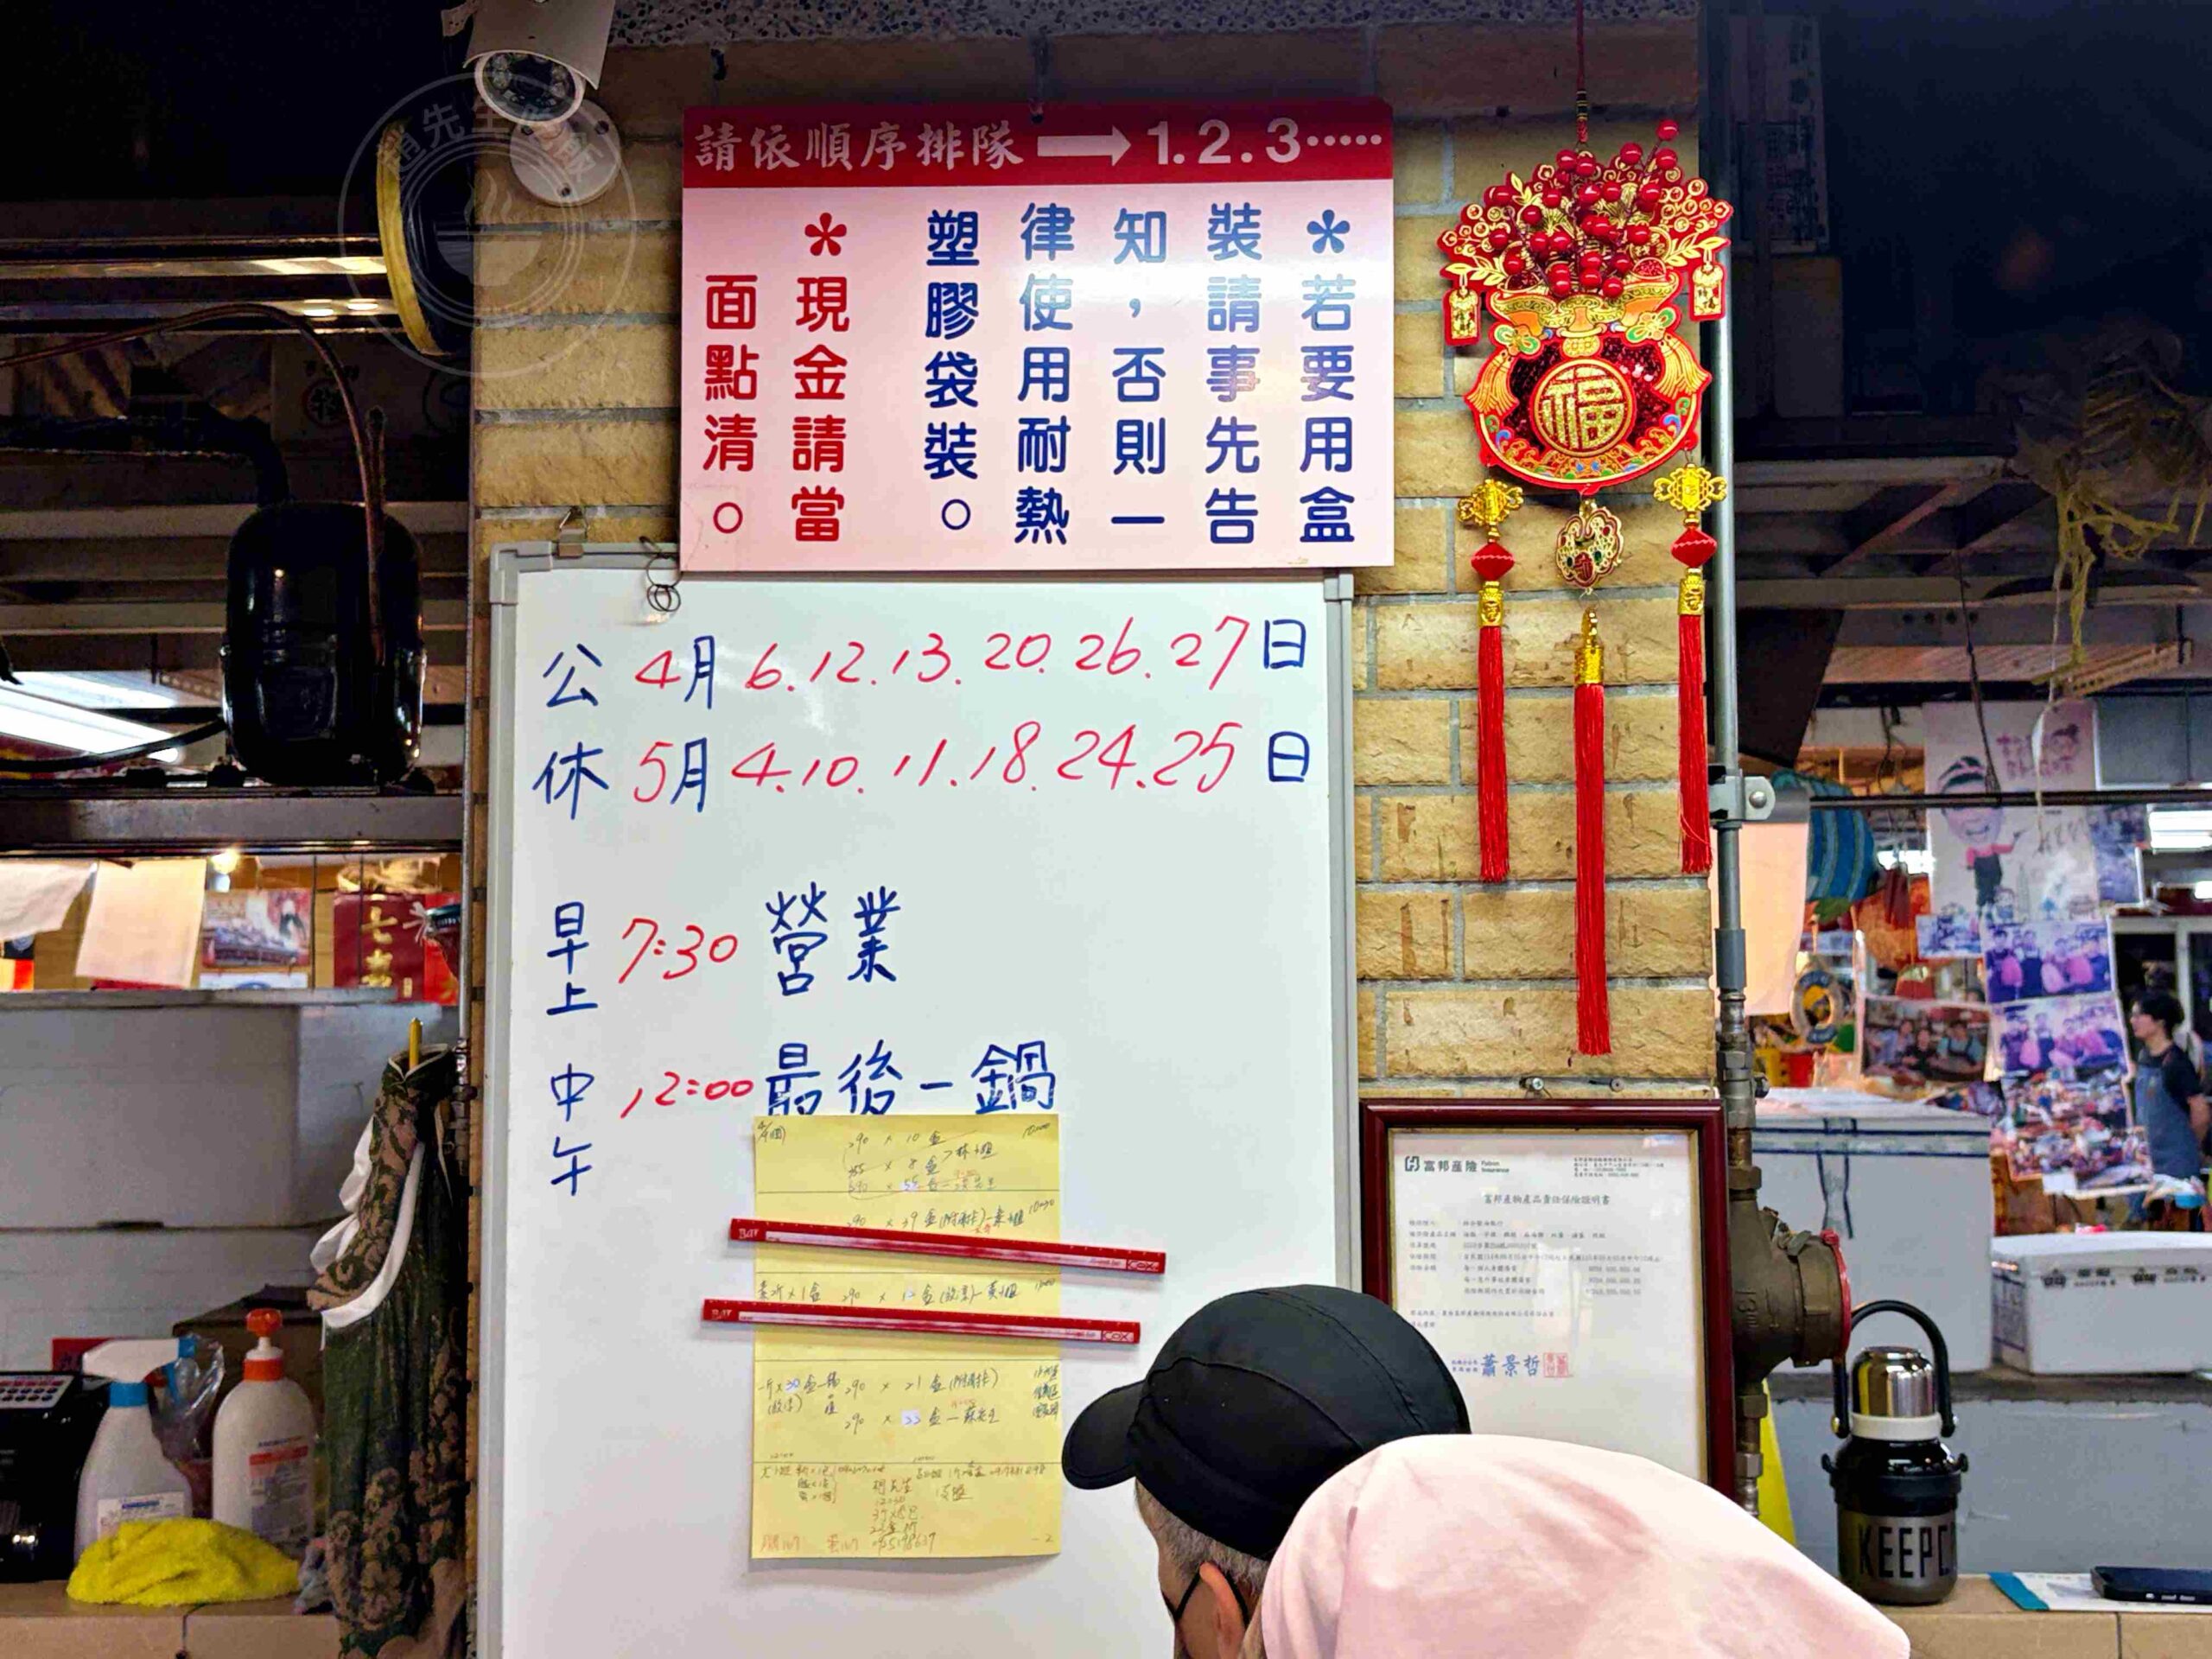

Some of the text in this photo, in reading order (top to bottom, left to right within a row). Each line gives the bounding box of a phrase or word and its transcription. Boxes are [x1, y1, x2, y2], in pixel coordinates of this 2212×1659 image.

[695, 121, 1025, 171] 請依順序排隊
[1014, 202, 1075, 544] 律使用耐熱
[1205, 202, 1262, 544] 裝請事先告
[1541, 366, 1627, 448] 福
[547, 900, 598, 1015] 早上
[619, 881, 899, 995] 7:30 營業
[550, 1063, 595, 1196] 中午
[620, 1071, 754, 1119] 12:00
